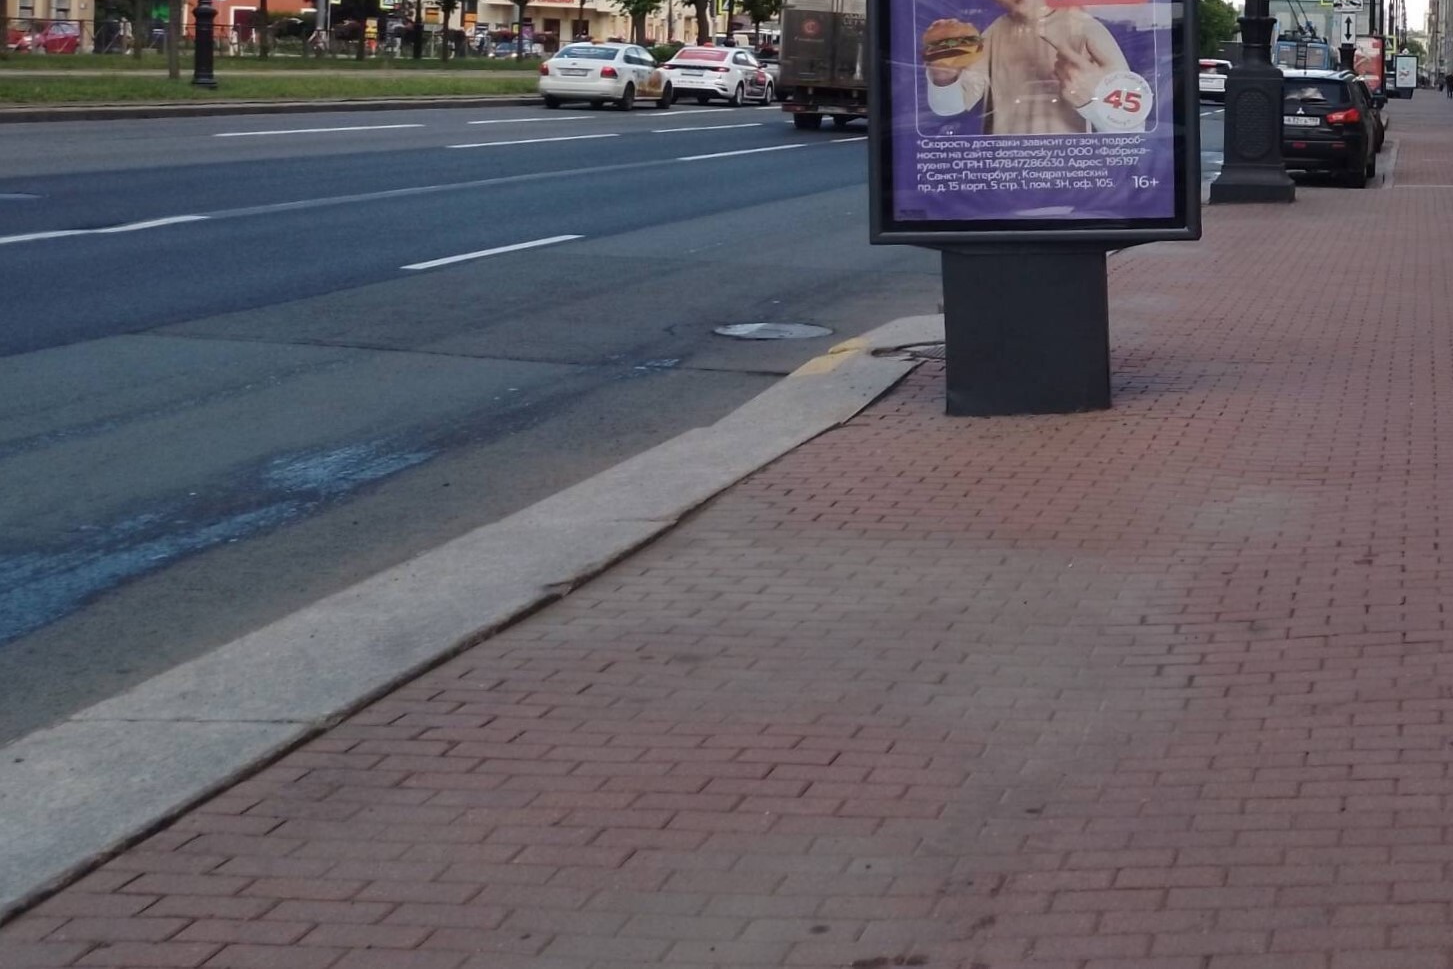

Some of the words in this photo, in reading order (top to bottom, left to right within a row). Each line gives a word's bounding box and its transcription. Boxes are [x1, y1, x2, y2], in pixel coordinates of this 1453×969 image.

[1102, 89, 1142, 113] 45
[972, 139, 1020, 149] доставки
[1022, 138, 1063, 147] зависит
[1065, 138, 1076, 146] от
[916, 151, 947, 159] ности
[949, 151, 962, 159] на
[963, 150, 994, 159] сайте
[995, 147, 1065, 160] dostaevsky.ru
[1067, 147, 1093, 156] ООО
[952, 160, 983, 170] ОГРН
[1022, 168, 1108, 180] Кондратьевский
[948, 182, 959, 191] 15
[1132, 176, 1159, 189] 16+
